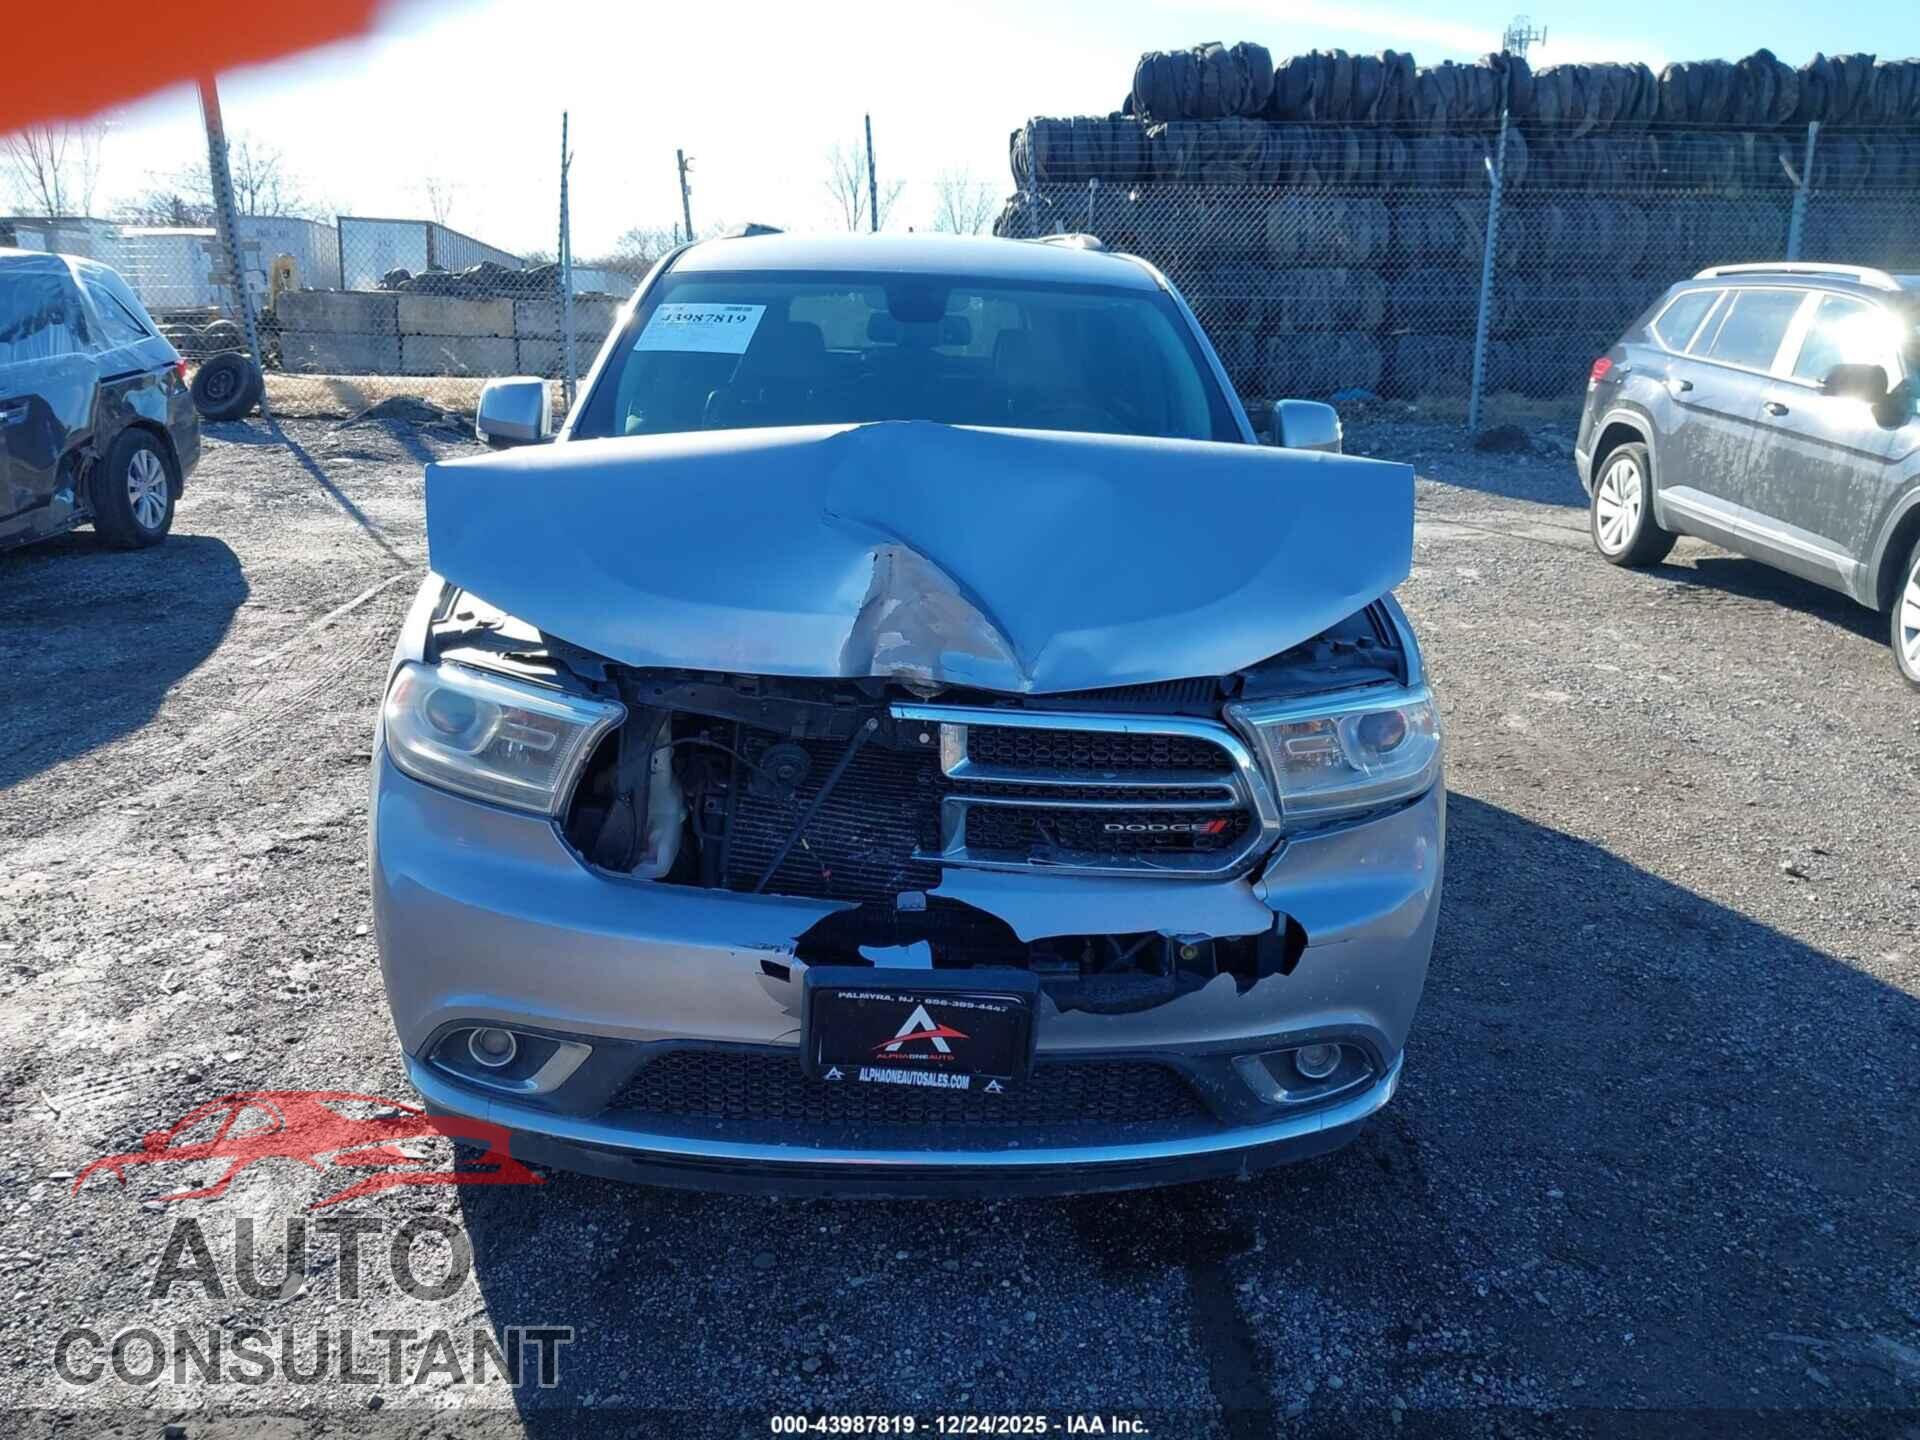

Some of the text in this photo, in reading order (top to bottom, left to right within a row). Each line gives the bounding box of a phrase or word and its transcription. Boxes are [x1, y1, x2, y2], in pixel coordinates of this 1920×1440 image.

[1104, 823, 1210, 833] DODGE
[898, 995, 914, 1003] NJ
[859, 1067, 971, 1090] ALPHAONEAUTOSALES.COM
